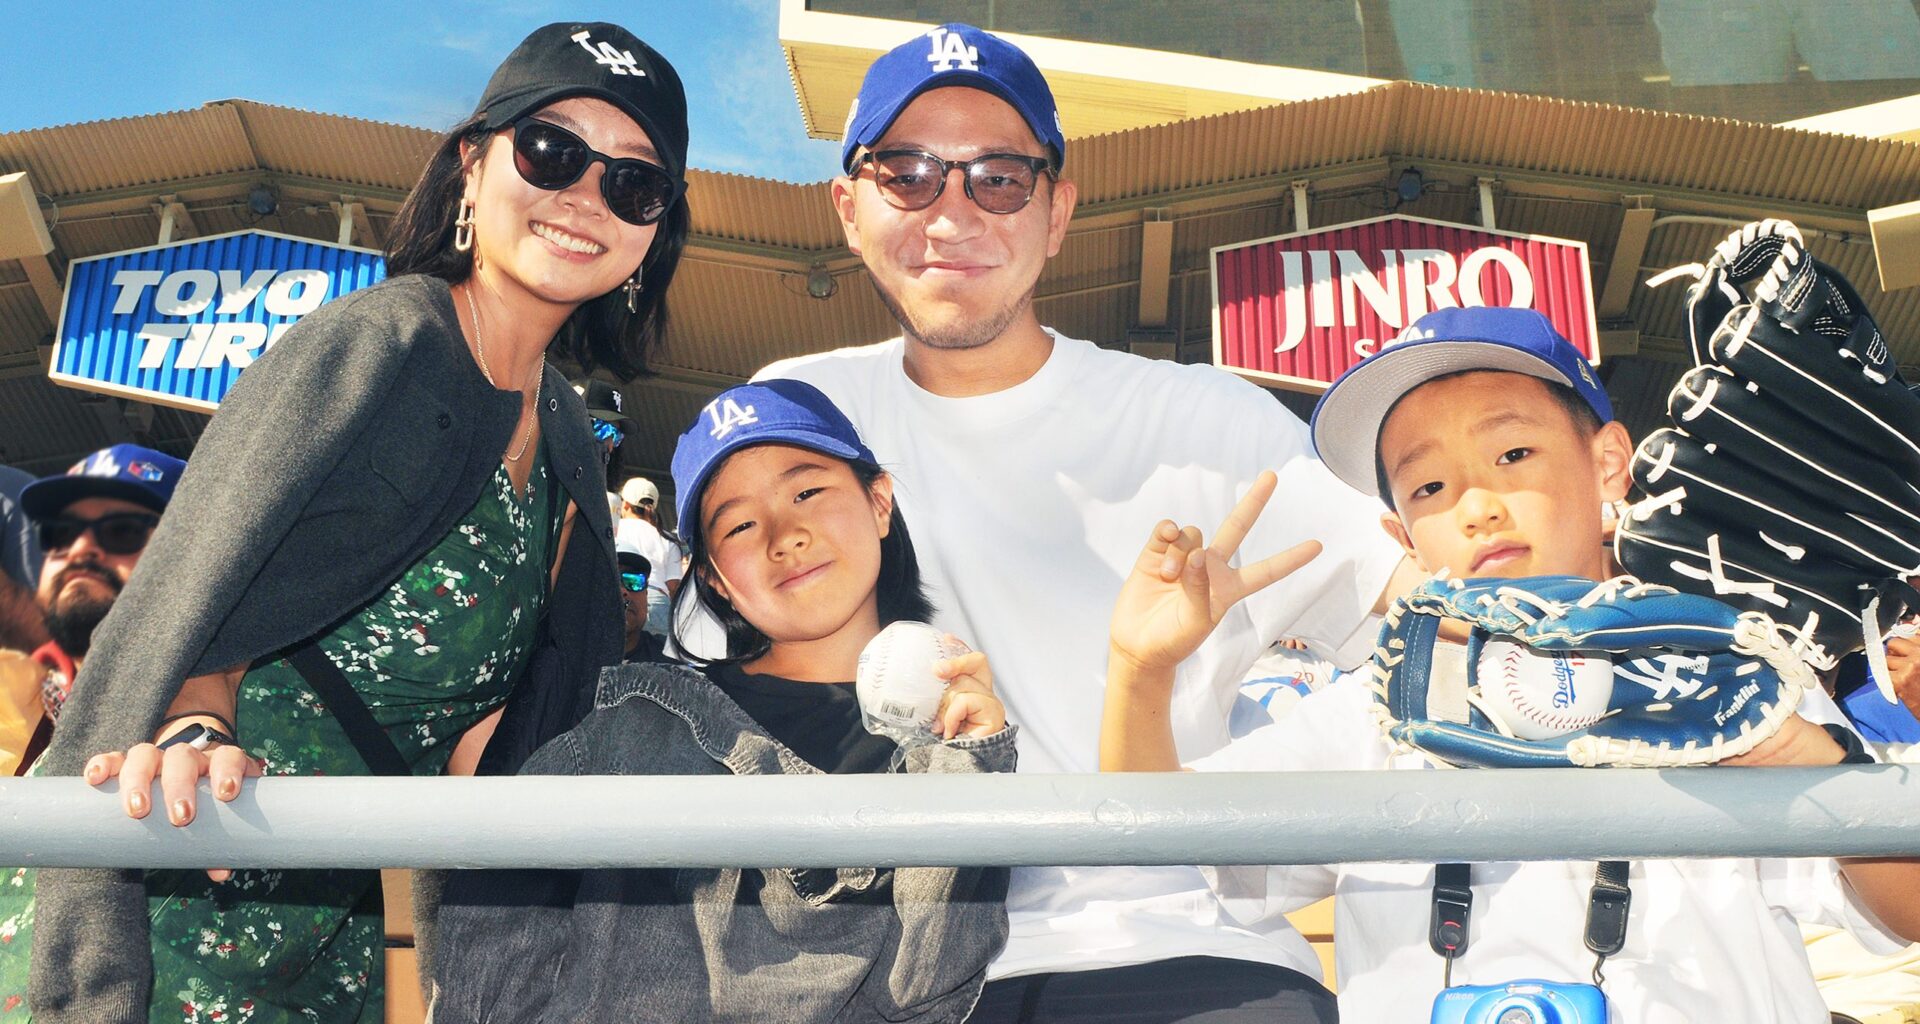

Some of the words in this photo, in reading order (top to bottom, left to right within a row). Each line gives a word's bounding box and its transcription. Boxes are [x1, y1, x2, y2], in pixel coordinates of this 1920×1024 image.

[570, 30, 646, 77] LA
[927, 28, 979, 73] LA
[111, 269, 330, 316] TOYO
[1274, 246, 1535, 354] JINRO
[703, 397, 759, 441] LA
[1713, 681, 1761, 727] Franklin
[1444, 992, 1475, 1001] Nikon
